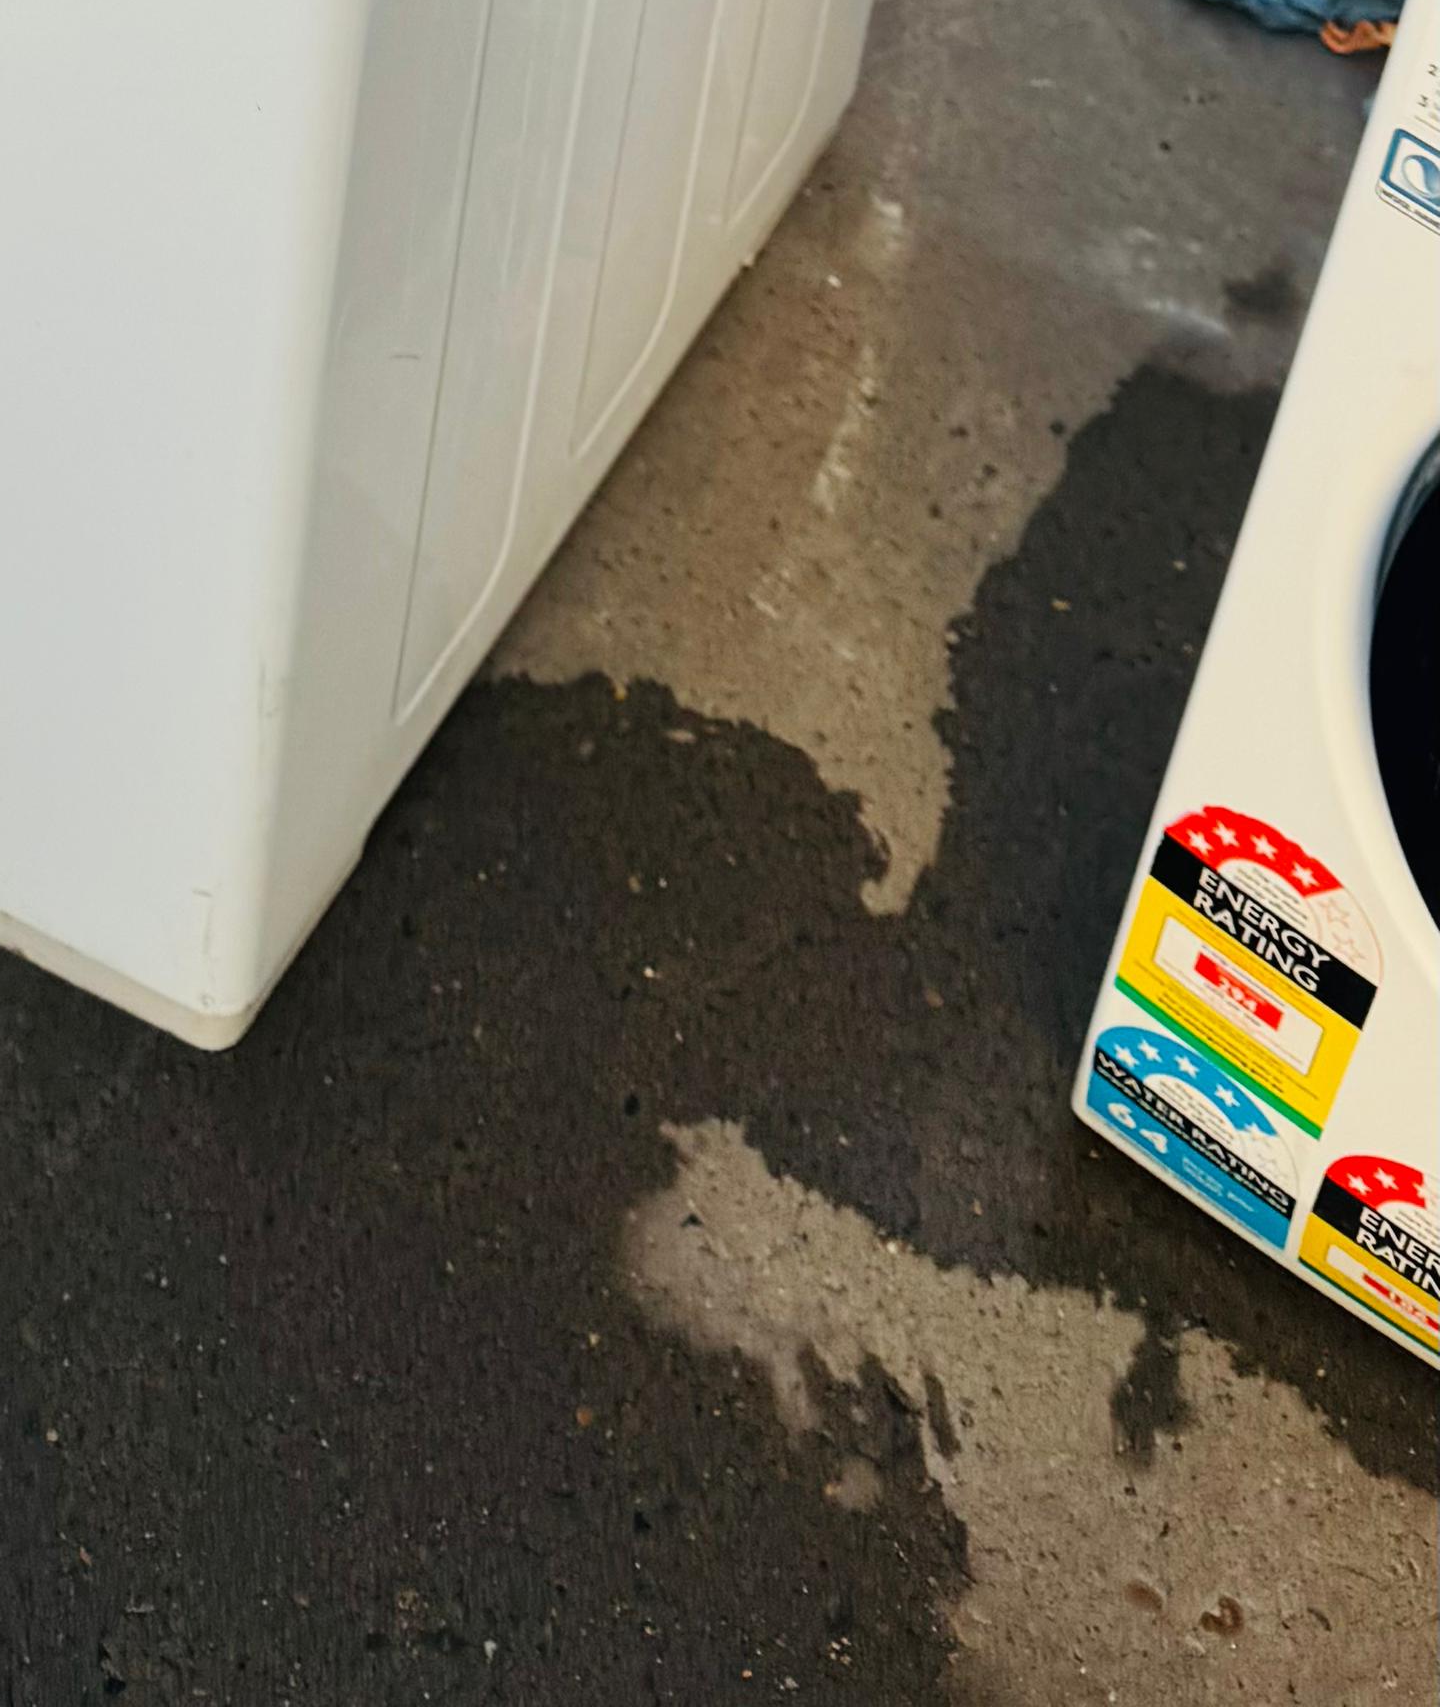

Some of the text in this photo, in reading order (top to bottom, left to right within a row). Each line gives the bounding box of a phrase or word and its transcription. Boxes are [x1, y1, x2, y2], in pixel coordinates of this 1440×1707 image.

[1193, 890, 1320, 993] RATING
[1198, 866, 1332, 969] ENERGY
[1097, 1051, 1185, 1130] WATER
[1191, 1127, 1290, 1207] RATING
